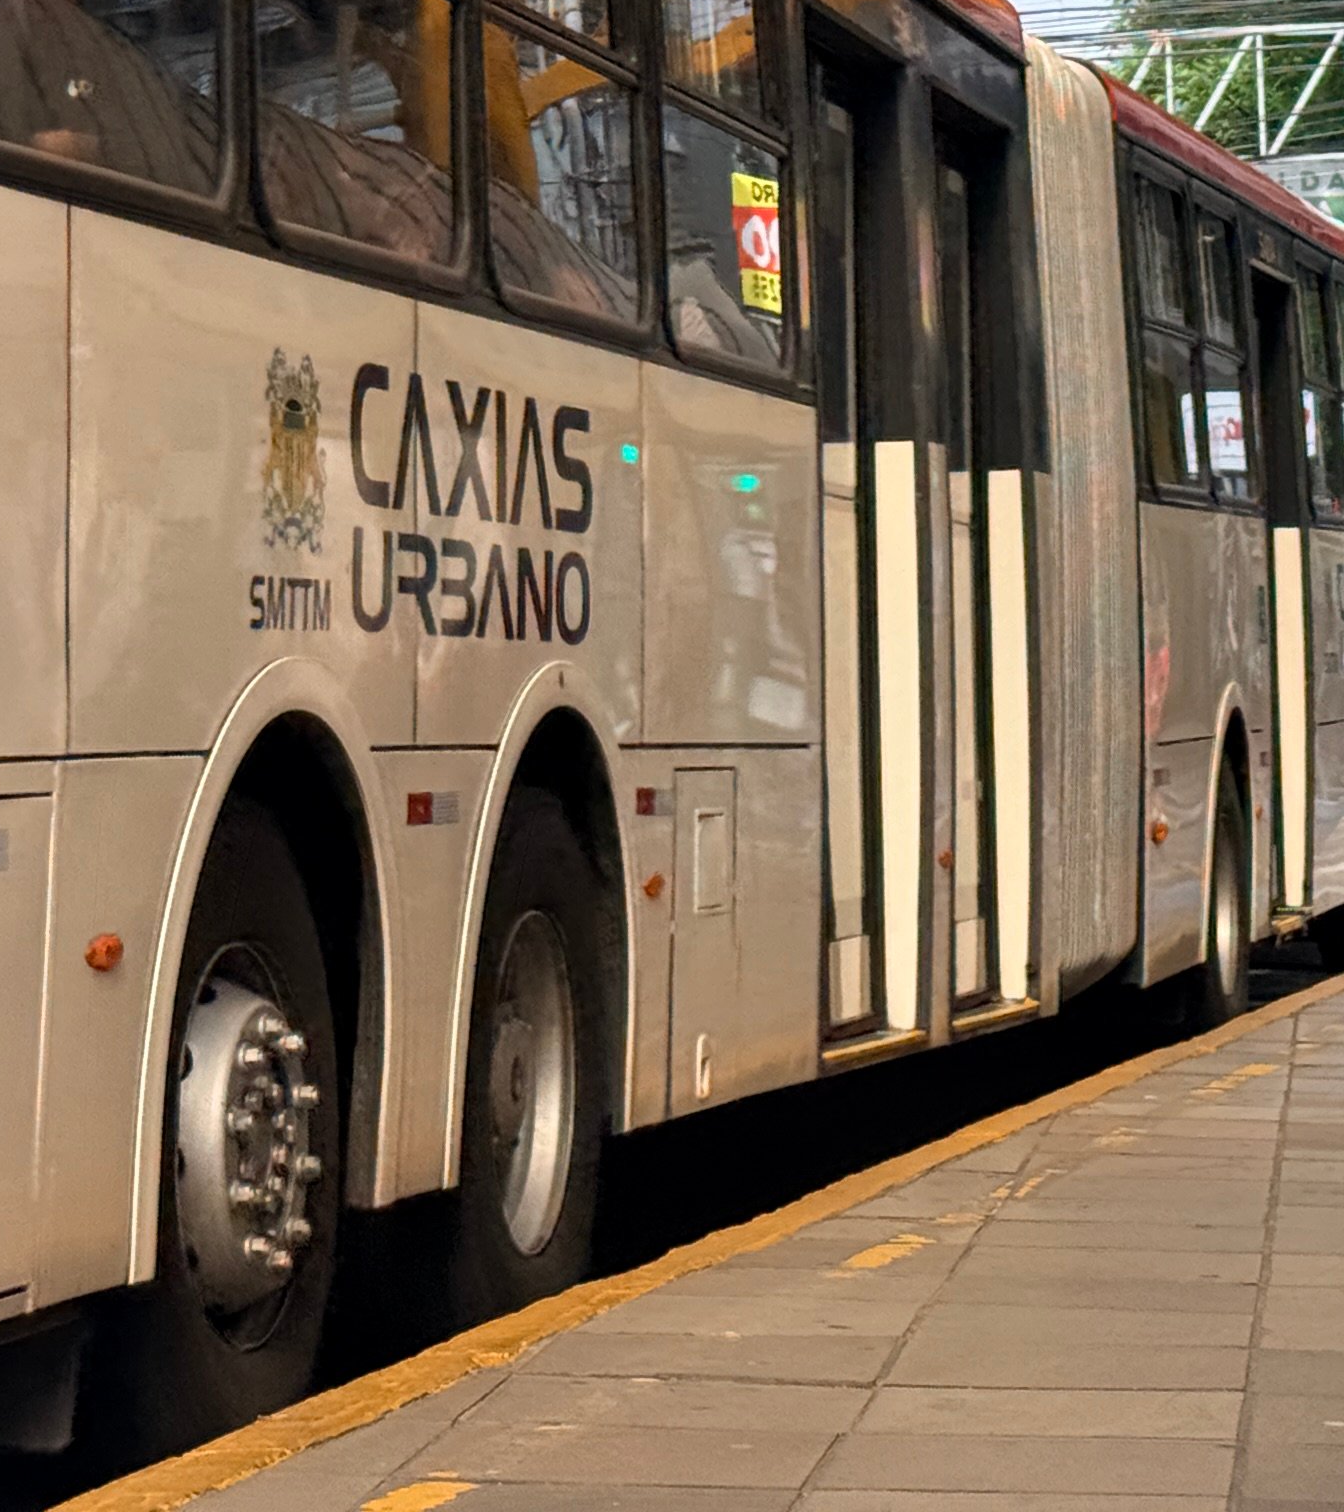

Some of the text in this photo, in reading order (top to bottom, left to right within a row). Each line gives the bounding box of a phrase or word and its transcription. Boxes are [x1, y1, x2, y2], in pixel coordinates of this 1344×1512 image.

[350, 362, 594, 535] CAXIAS
[249, 575, 332, 632] SMTTM
[352, 526, 592, 646] URBANO
